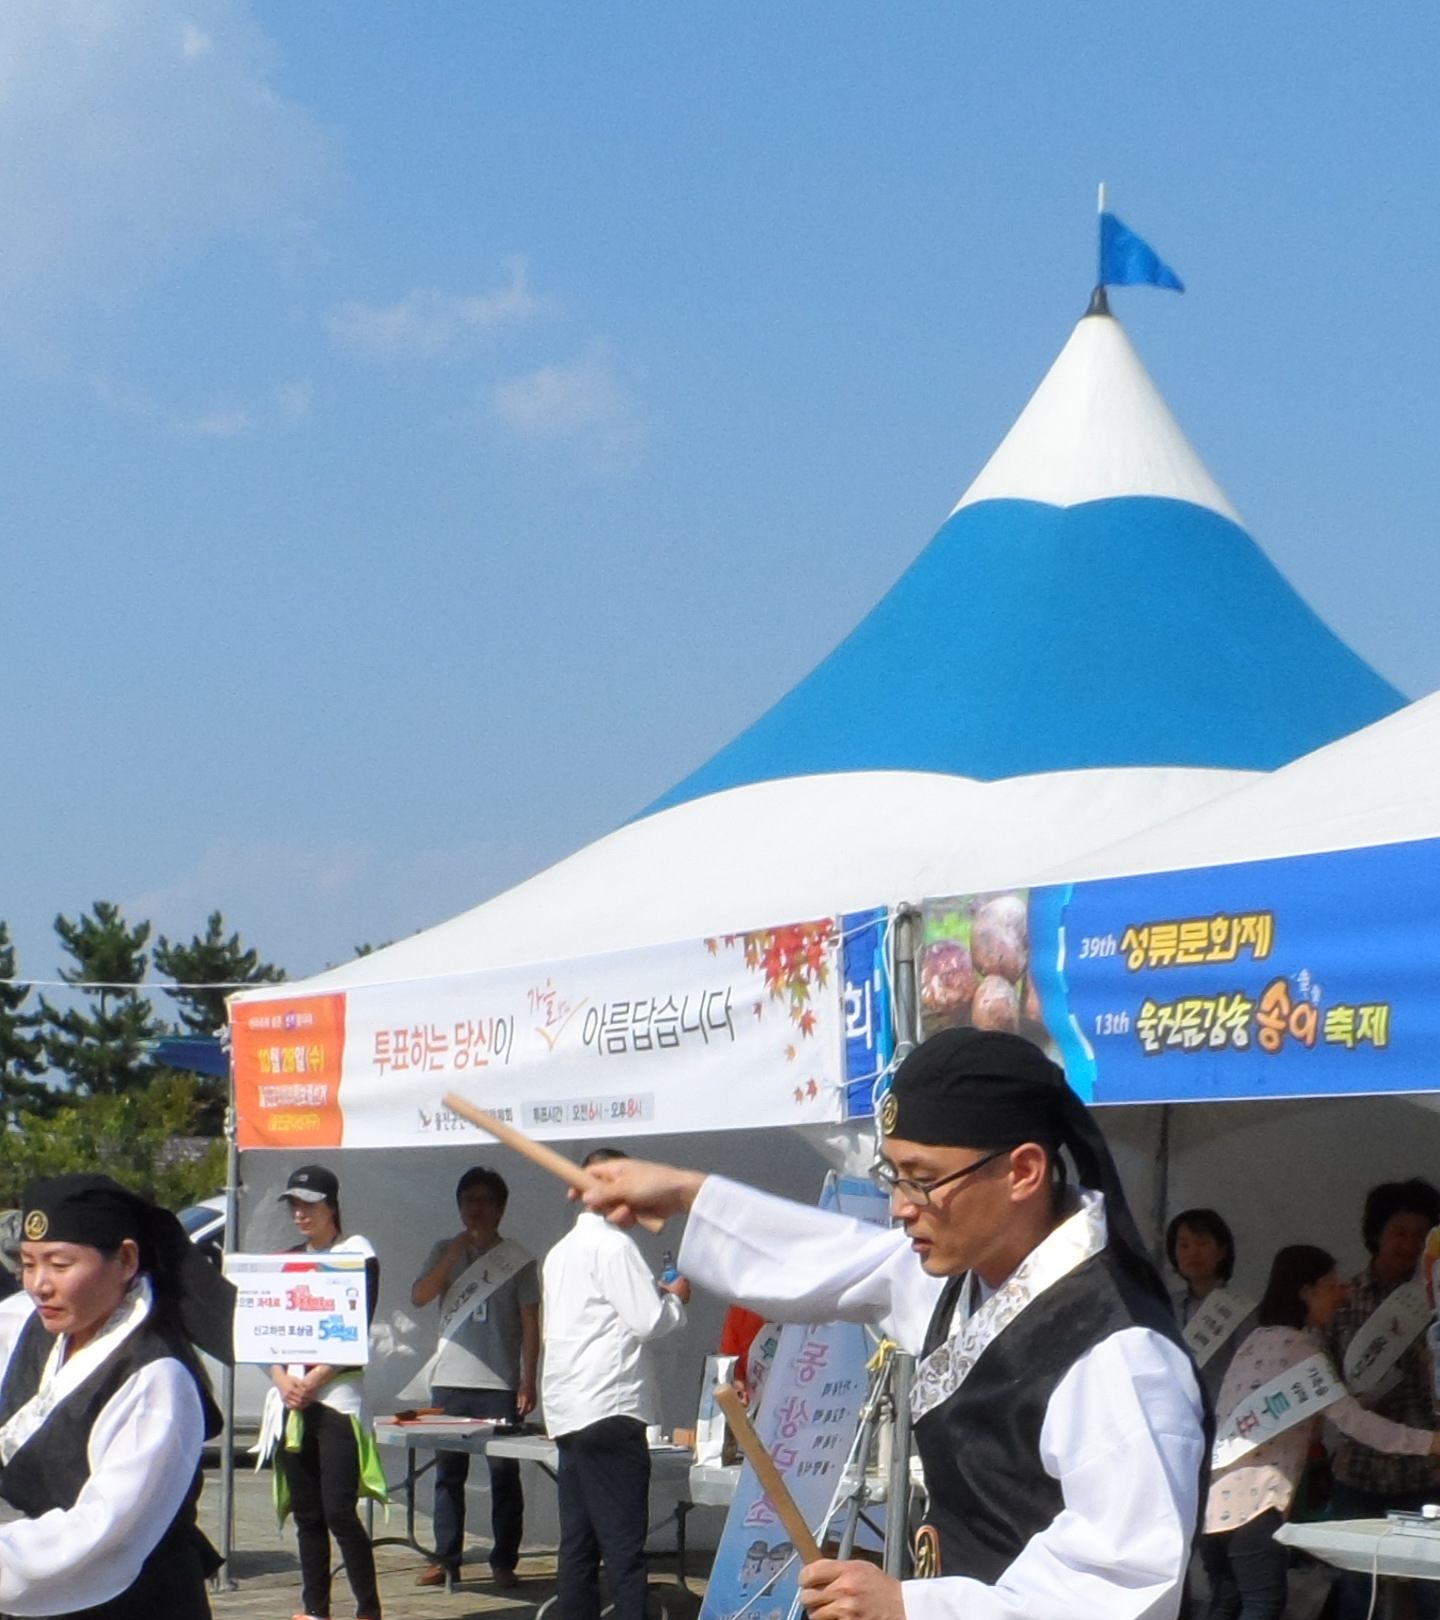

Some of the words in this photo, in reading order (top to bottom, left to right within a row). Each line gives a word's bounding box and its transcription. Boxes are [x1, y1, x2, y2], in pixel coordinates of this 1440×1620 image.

[1078, 934, 1117, 959] 39th
[1118, 911, 1273, 972] 성류문화제
[372, 1025, 449, 1076] 투표하는
[453, 1015, 515, 1066] 당신이
[581, 985, 735, 1056] 아름답습니다
[1095, 1011, 1130, 1035] 13th
[1323, 1003, 1390, 1049] 축제
[533, 1105, 563, 1124] 투표시간
[572, 1101, 603, 1122] 오전6시
[610, 1097, 643, 1119] 오후8시
